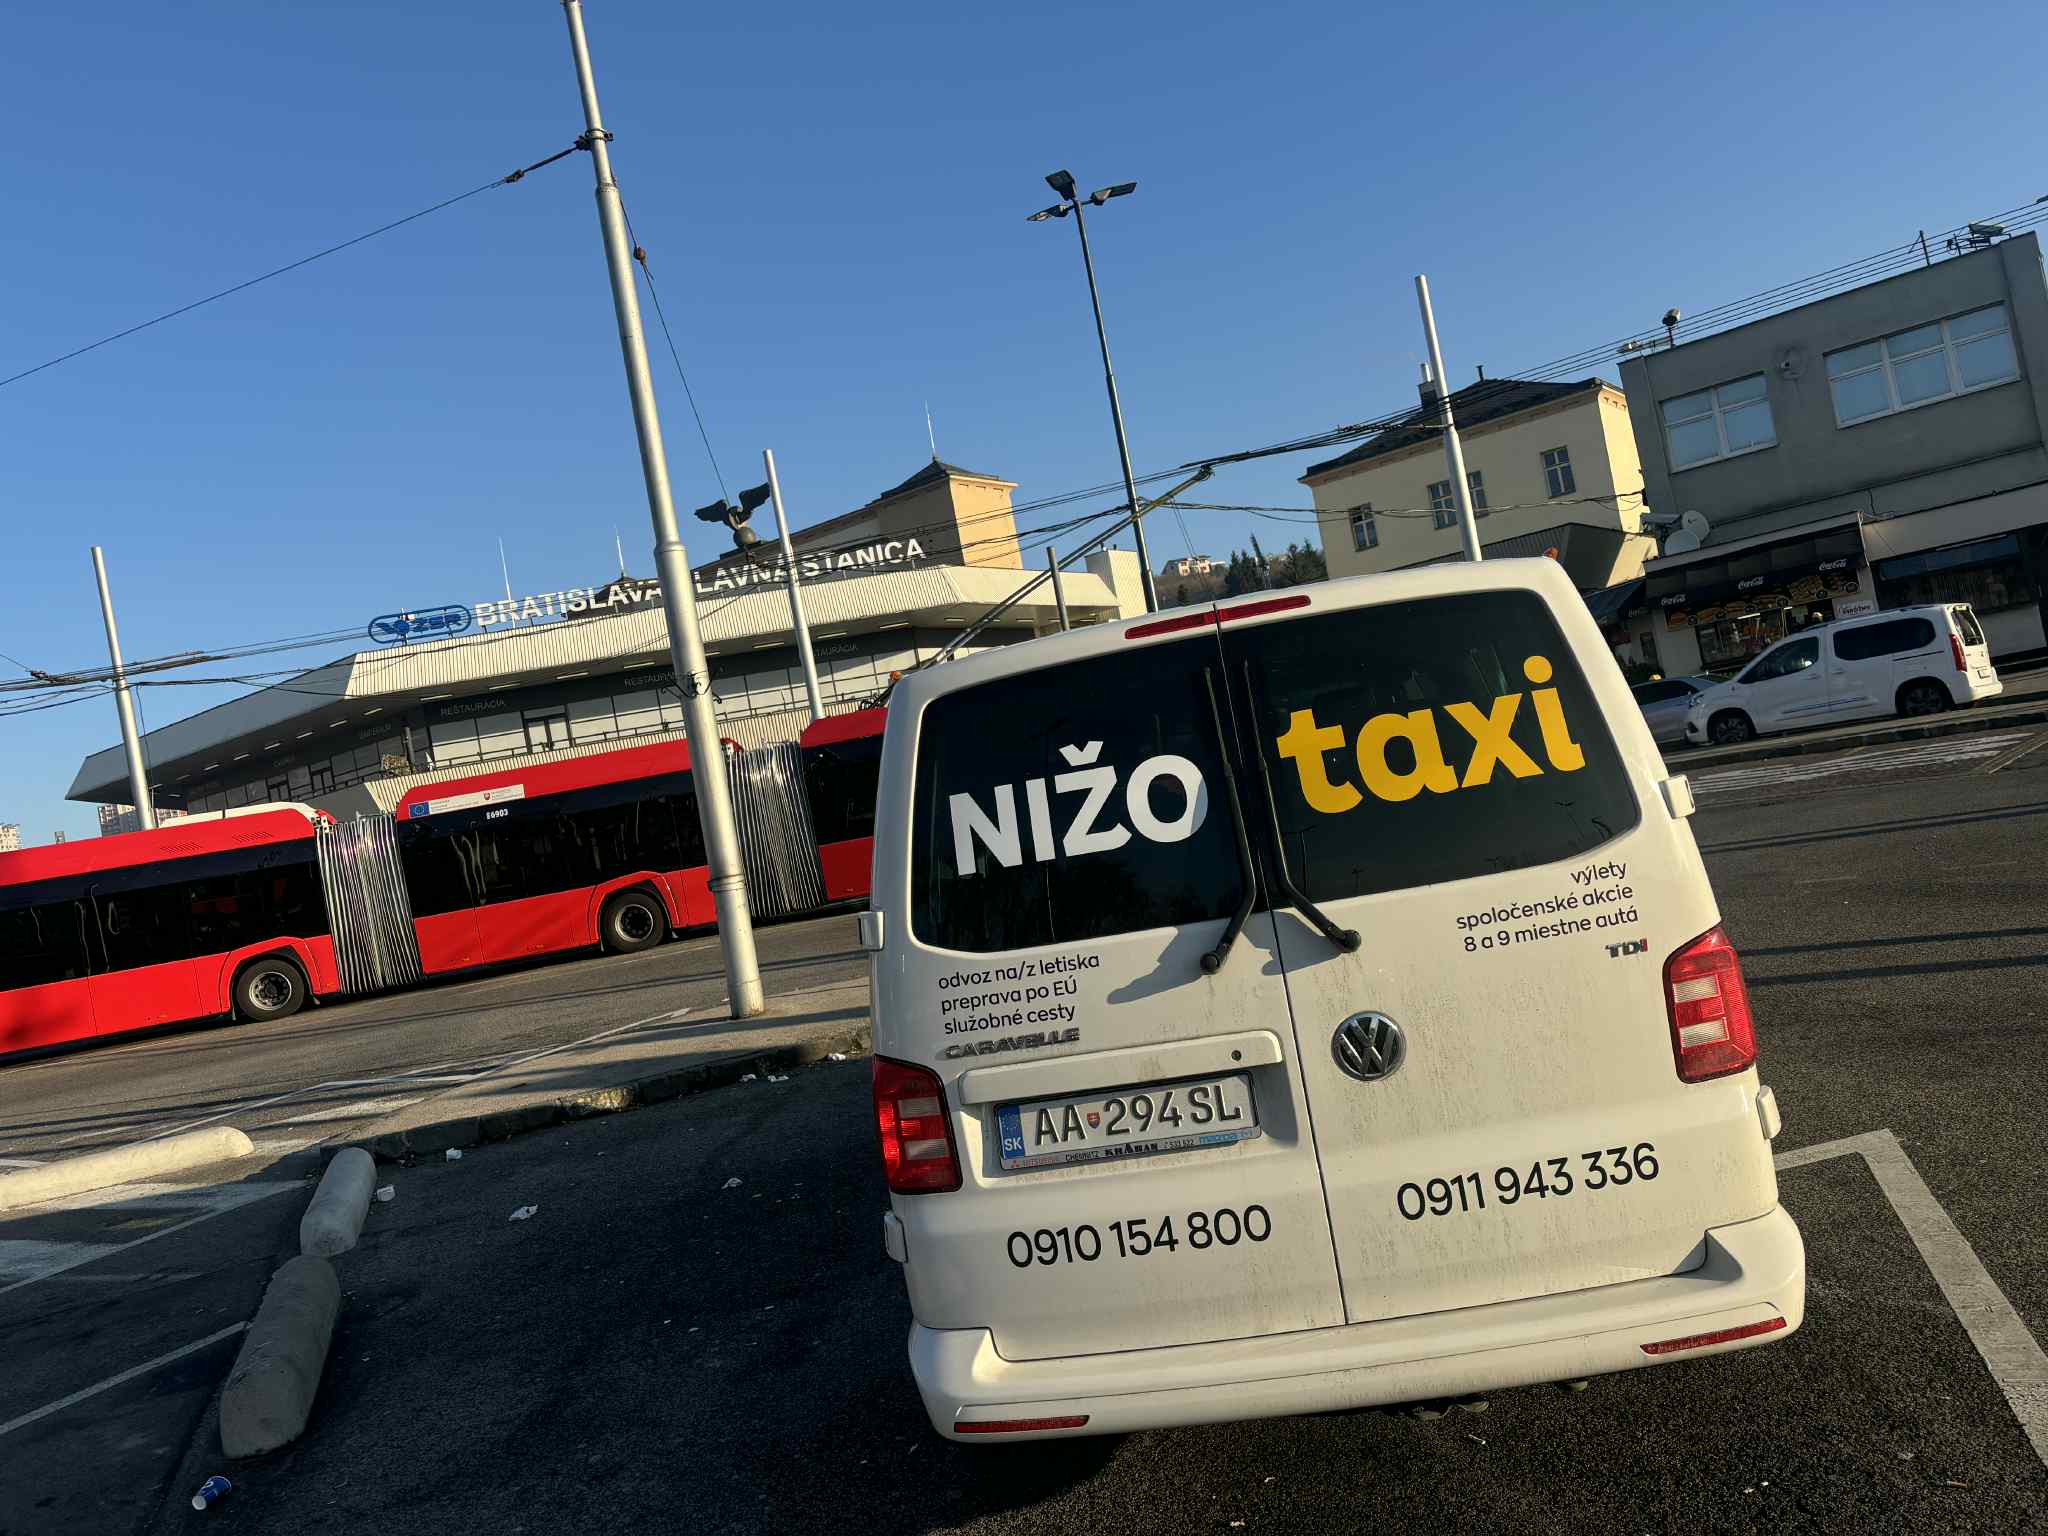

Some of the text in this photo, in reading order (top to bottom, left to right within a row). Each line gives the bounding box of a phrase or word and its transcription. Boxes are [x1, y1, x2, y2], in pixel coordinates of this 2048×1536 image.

[800, 538, 927, 577] STANICA
[1276, 655, 1586, 814] taxi
[949, 740, 1209, 876] NIŽO
[1570, 861, 1627, 886] výlety
[1456, 884, 1633, 931] spoločenské akcie
[1464, 905, 1639, 952] 8 a 9 miestne autá
[1605, 938, 1649, 958] TDI
[938, 954, 1100, 990] odvoz na/z letiska
[941, 975, 1077, 1015] preprava po EÚ
[944, 1003, 1075, 1035] služobné cesty
[945, 1028, 1080, 1059] CARAVELLE
[1003, 1084, 1243, 1152] SK AA 294 SL
[1397, 1142, 1659, 1220] 0911 943 336
[1007, 1204, 1272, 1268] 0910 154 800
